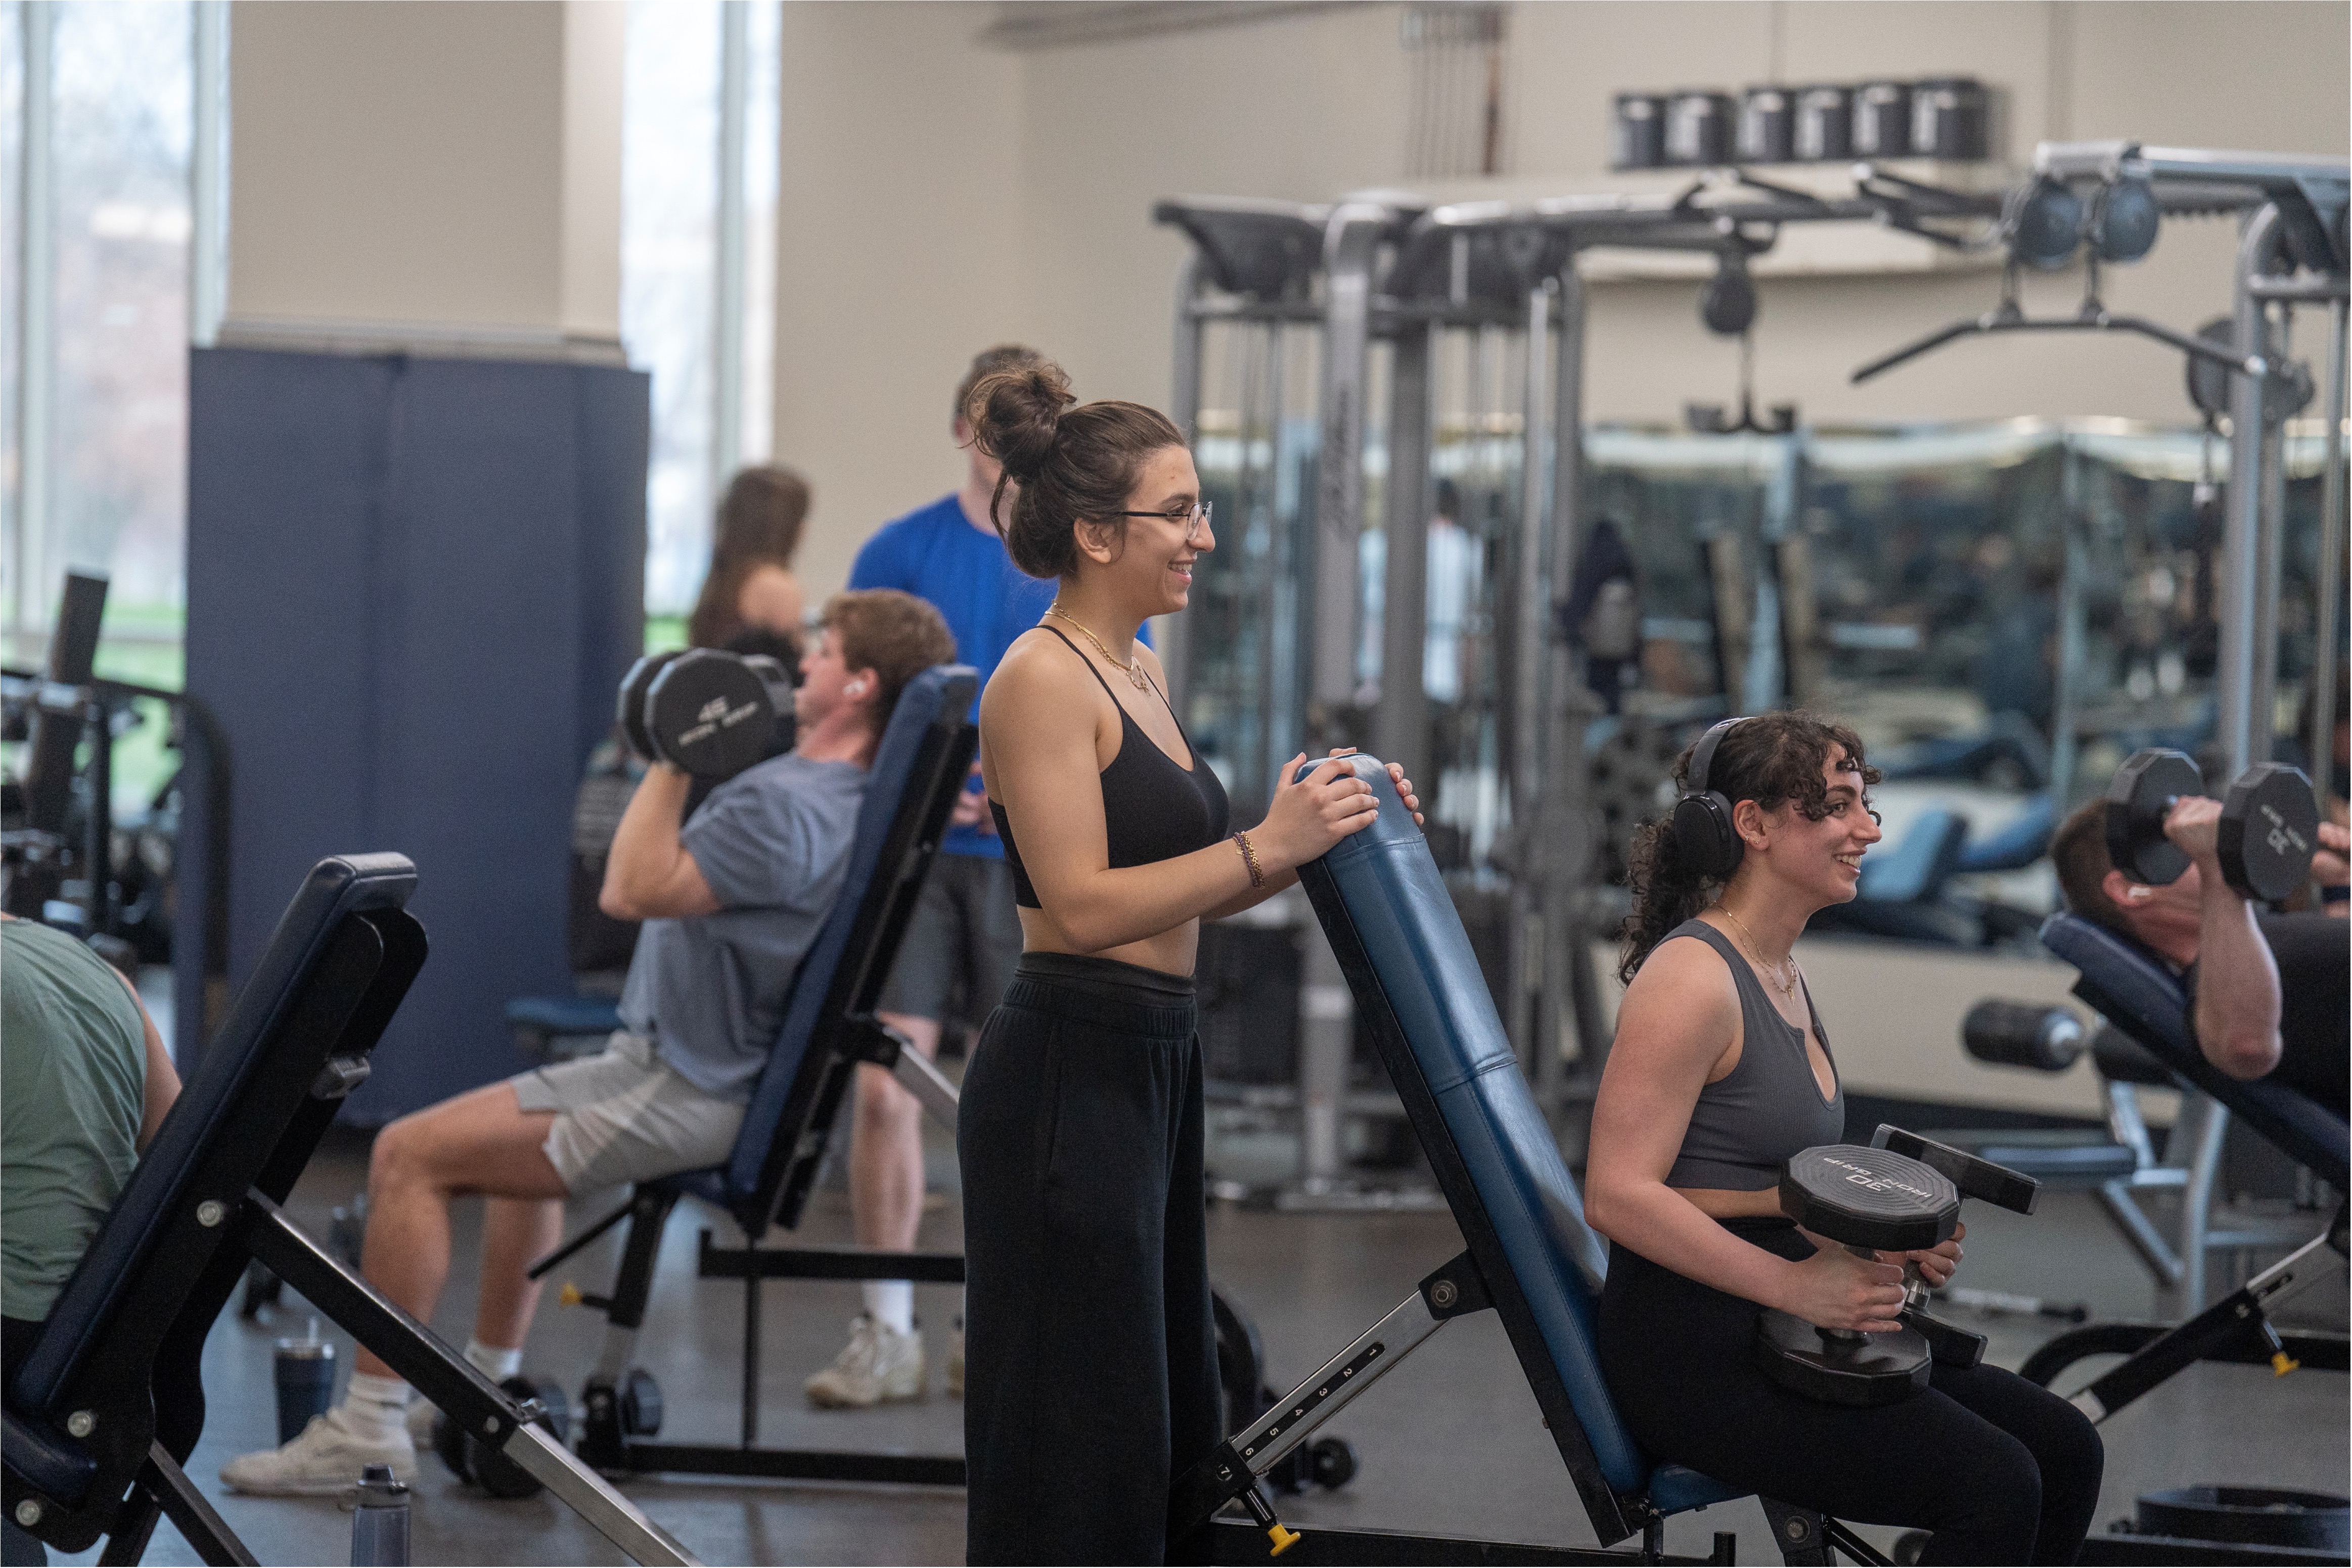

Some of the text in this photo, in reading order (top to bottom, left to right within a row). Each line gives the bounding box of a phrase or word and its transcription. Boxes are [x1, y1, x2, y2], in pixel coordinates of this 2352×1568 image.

[1824, 1158, 1932, 1197] IRON GRIP
[1845, 1174, 1892, 1191] 30
[1343, 1368, 1352, 1377] 2
[1319, 1388, 1328, 1396] 3
[1270, 1427, 1279, 1436] 5
[1245, 1447, 1254, 1456] 6
[1221, 1466, 1230, 1474] 7
